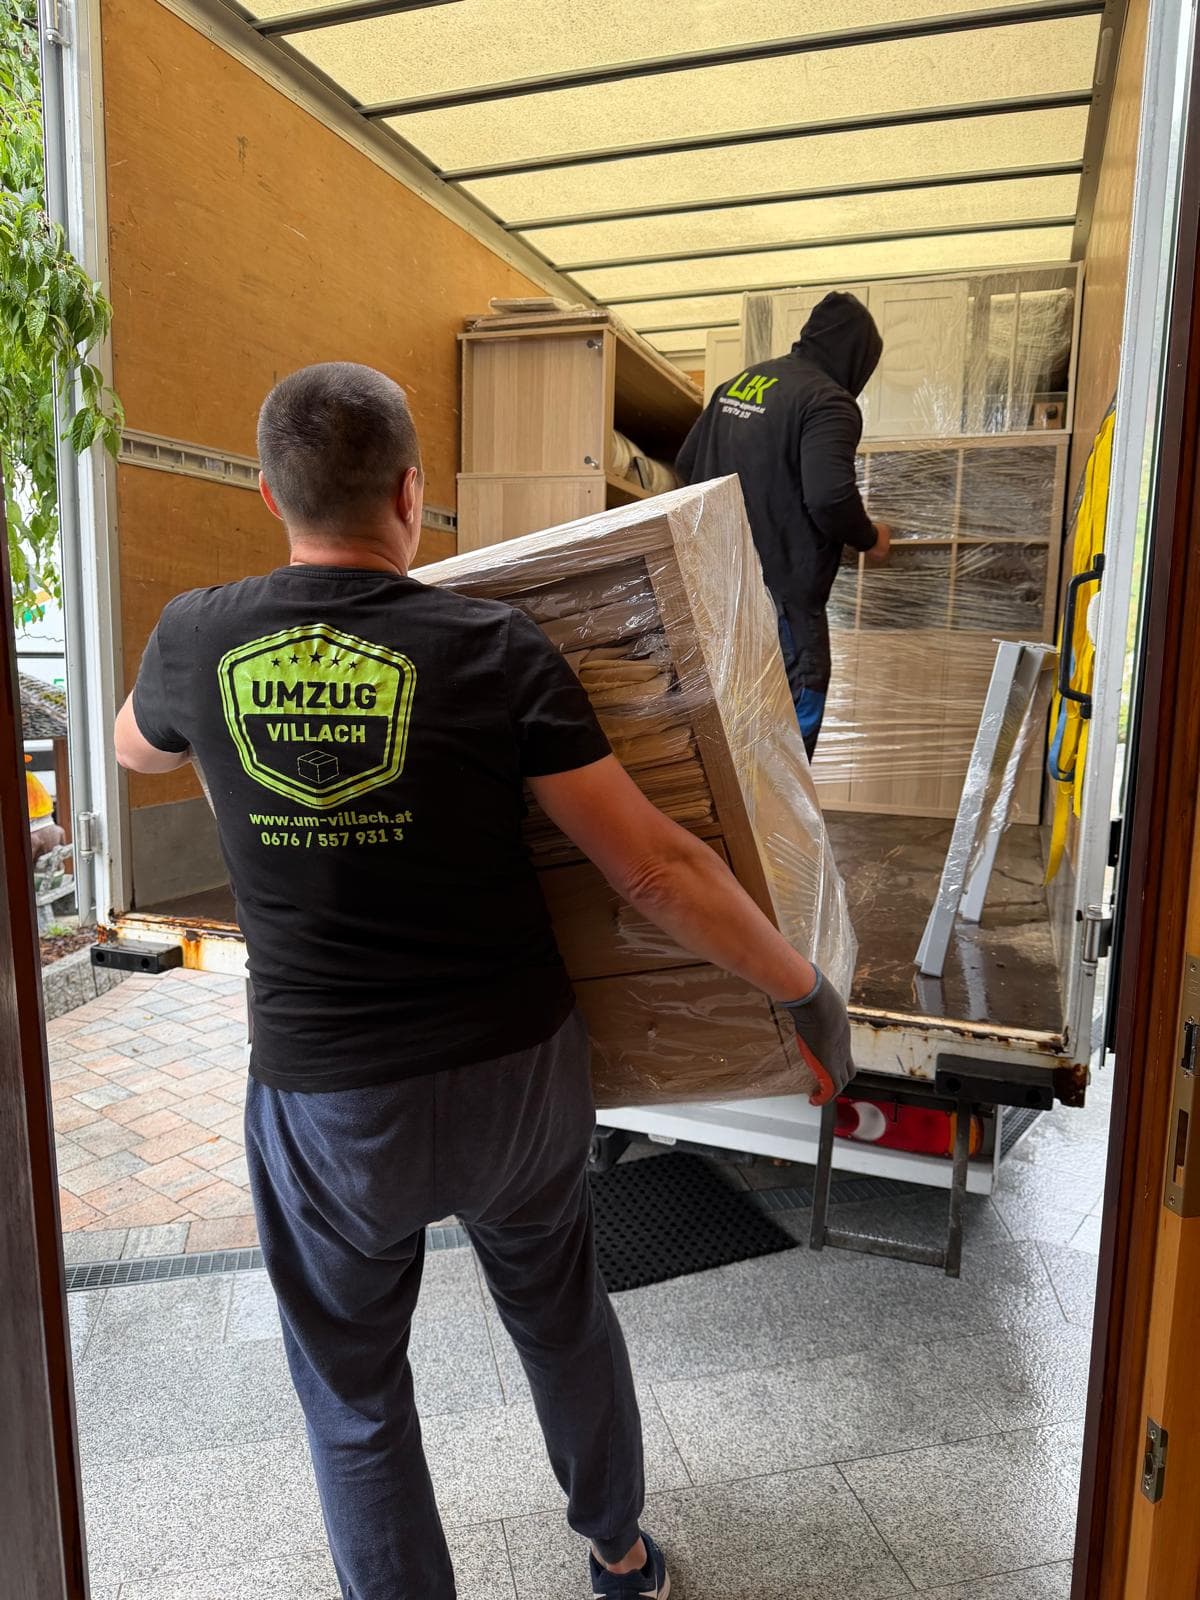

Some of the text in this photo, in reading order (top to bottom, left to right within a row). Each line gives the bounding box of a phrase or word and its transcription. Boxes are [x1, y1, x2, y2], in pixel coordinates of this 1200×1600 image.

[252, 680, 377, 709] UMZUG
[267, 723, 366, 743] VILLACH
[249, 810, 413, 827] www.um-villach.at
[261, 828, 404, 848] 0676 / 557 931 3
